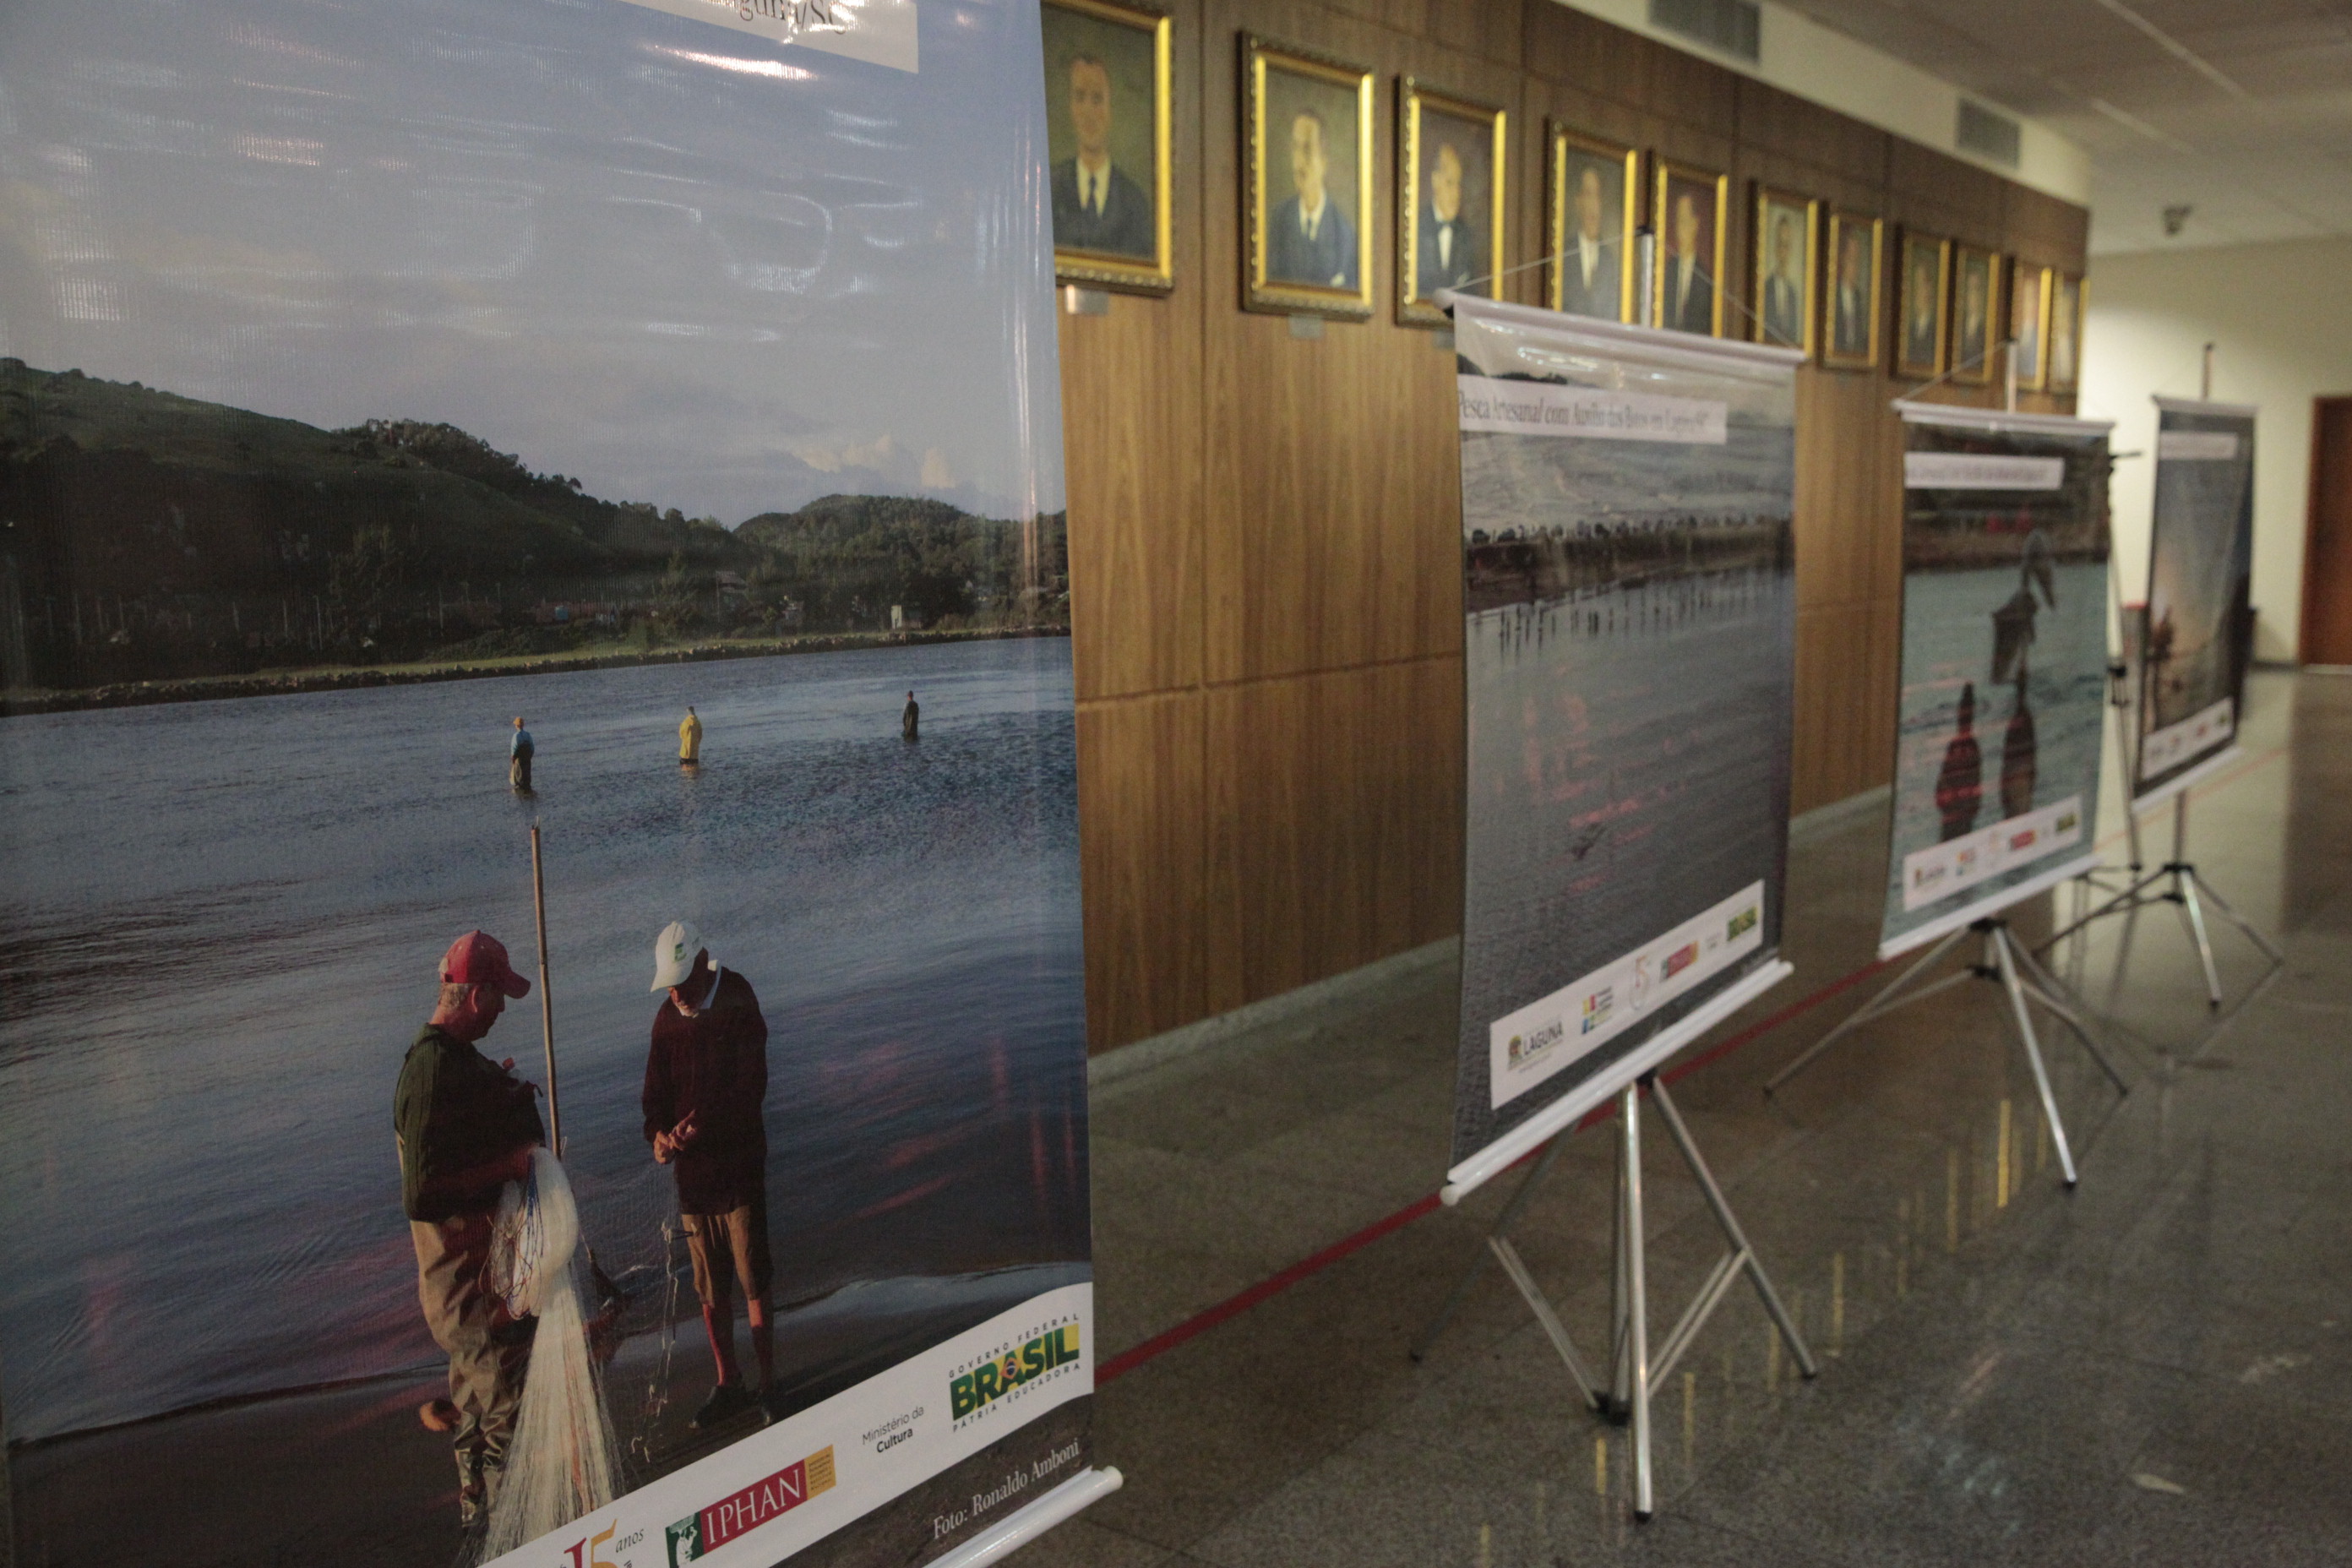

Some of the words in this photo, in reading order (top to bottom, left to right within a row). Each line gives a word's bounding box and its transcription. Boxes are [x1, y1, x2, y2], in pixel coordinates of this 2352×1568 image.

[949, 1342, 1010, 1379] GOVERNO
[1017, 1313, 1080, 1344] FEDERAL
[950, 1326, 1080, 1422] BRASIL
[862, 1413, 910, 1446] Ministério
[912, 1406, 924, 1420] da
[953, 1404, 998, 1433] PÁTRIA
[1007, 1363, 1081, 1404] EDUCADORA
[877, 1428, 913, 1453] Cultura
[706, 1468, 801, 1545] IPHAN
[933, 1507, 968, 1540] Foto:
[972, 1470, 1028, 1517] Ronaldo
[1030, 1437, 1080, 1483] Amboni
[615, 1528, 645, 1554] anos
